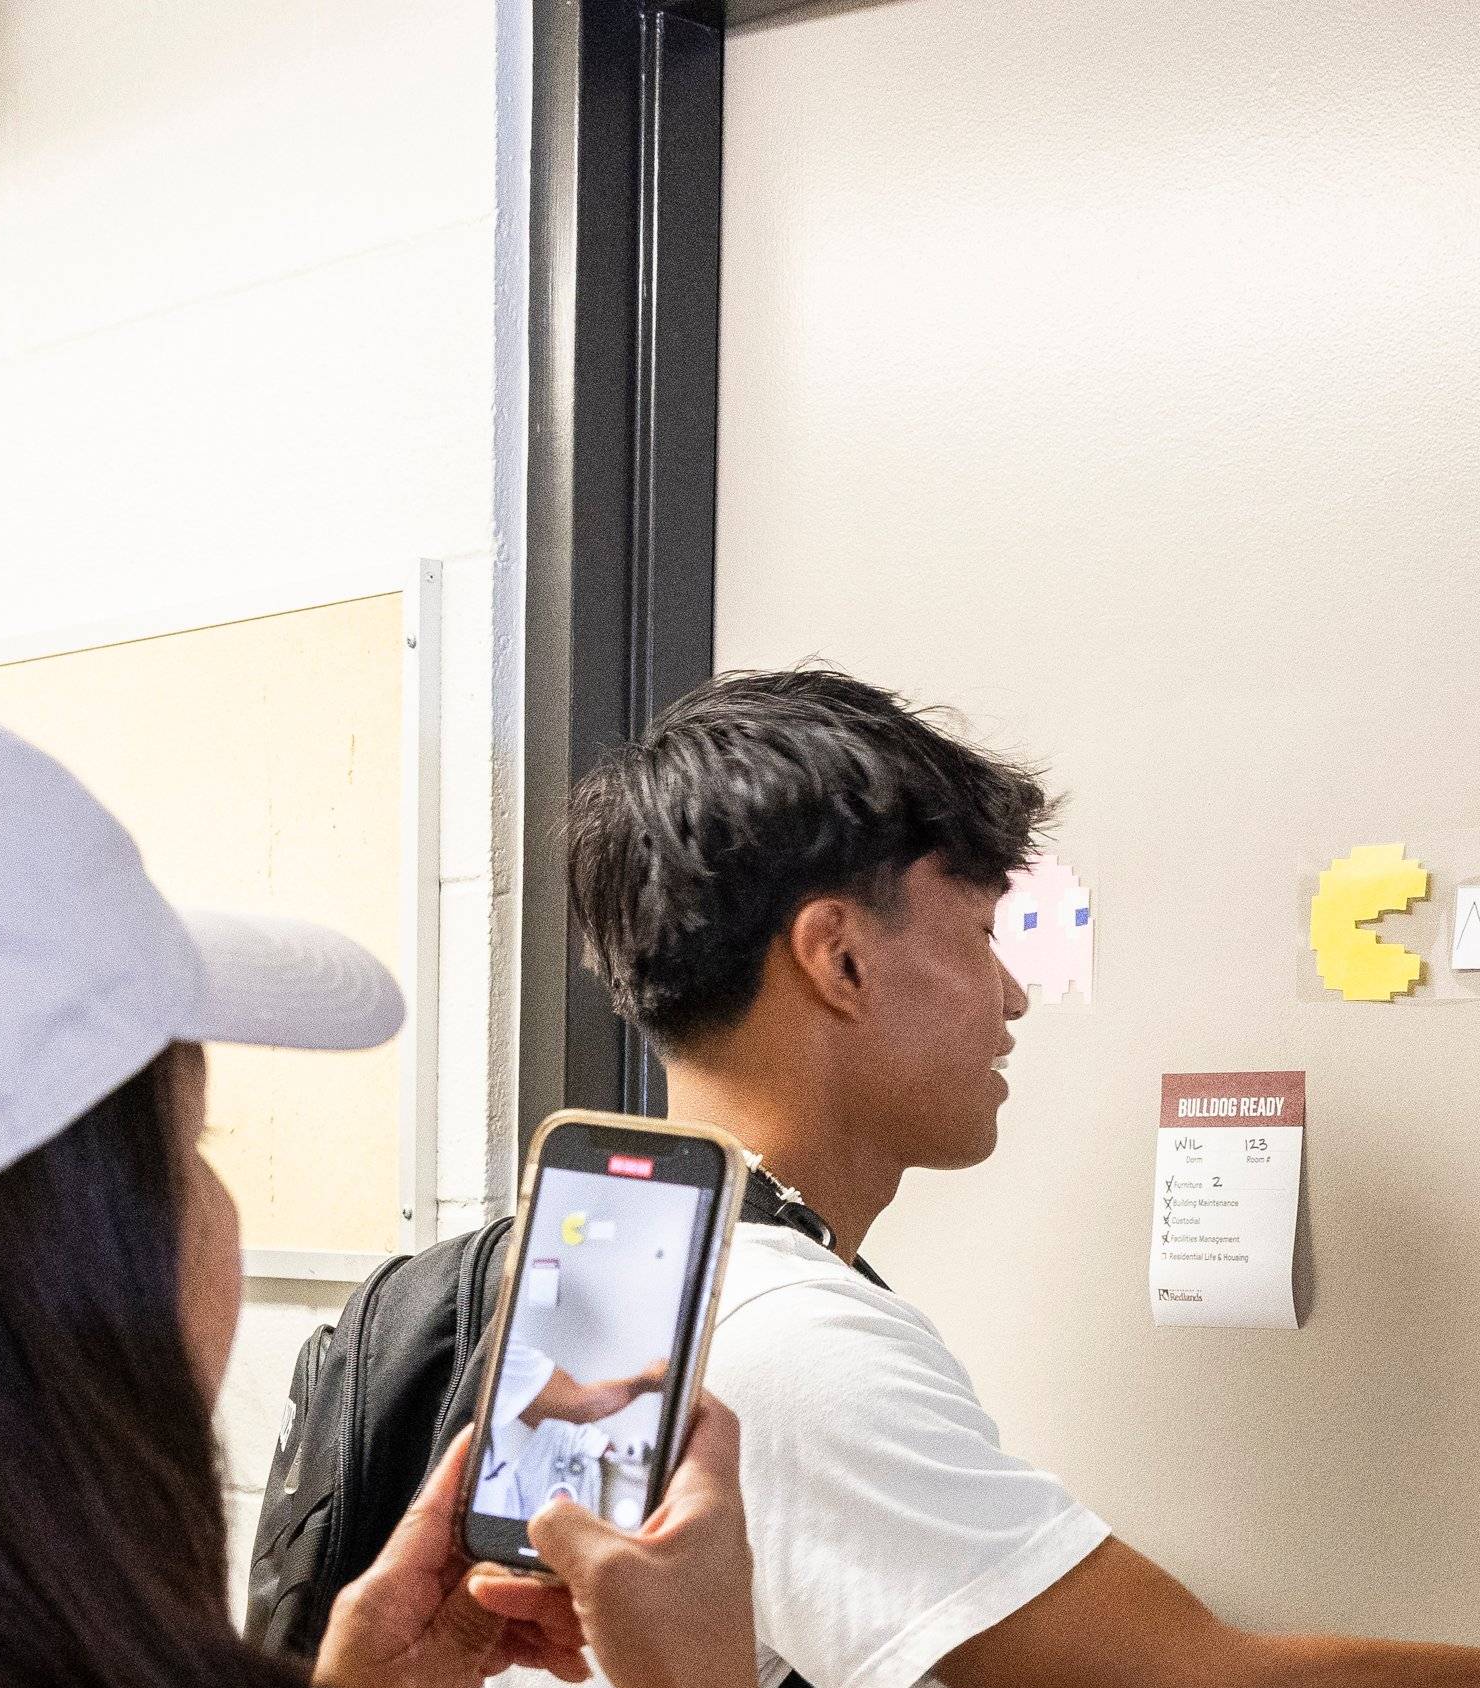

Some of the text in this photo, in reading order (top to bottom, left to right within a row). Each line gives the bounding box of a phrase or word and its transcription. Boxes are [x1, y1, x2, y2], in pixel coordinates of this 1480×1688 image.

[1178, 1097, 1285, 1118] BULLDOG READY
[1174, 1137, 1203, 1151] WIL
[1245, 1138, 1268, 1151] 123
[1186, 1156, 1203, 1164] Dorm
[1246, 1156, 1265, 1164] Room
[1174, 1180, 1203, 1189] Furniture
[1212, 1176, 1223, 1188] 2
[1173, 1199, 1239, 1208] Building Maintenance
[1172, 1216, 1201, 1225] Custodial
[1171, 1234, 1240, 1244] Facilities Management
[1169, 1252, 1203, 1261] Residential
[1204, 1253, 1216, 1261] Life
[1223, 1253, 1249, 1263] Housing
